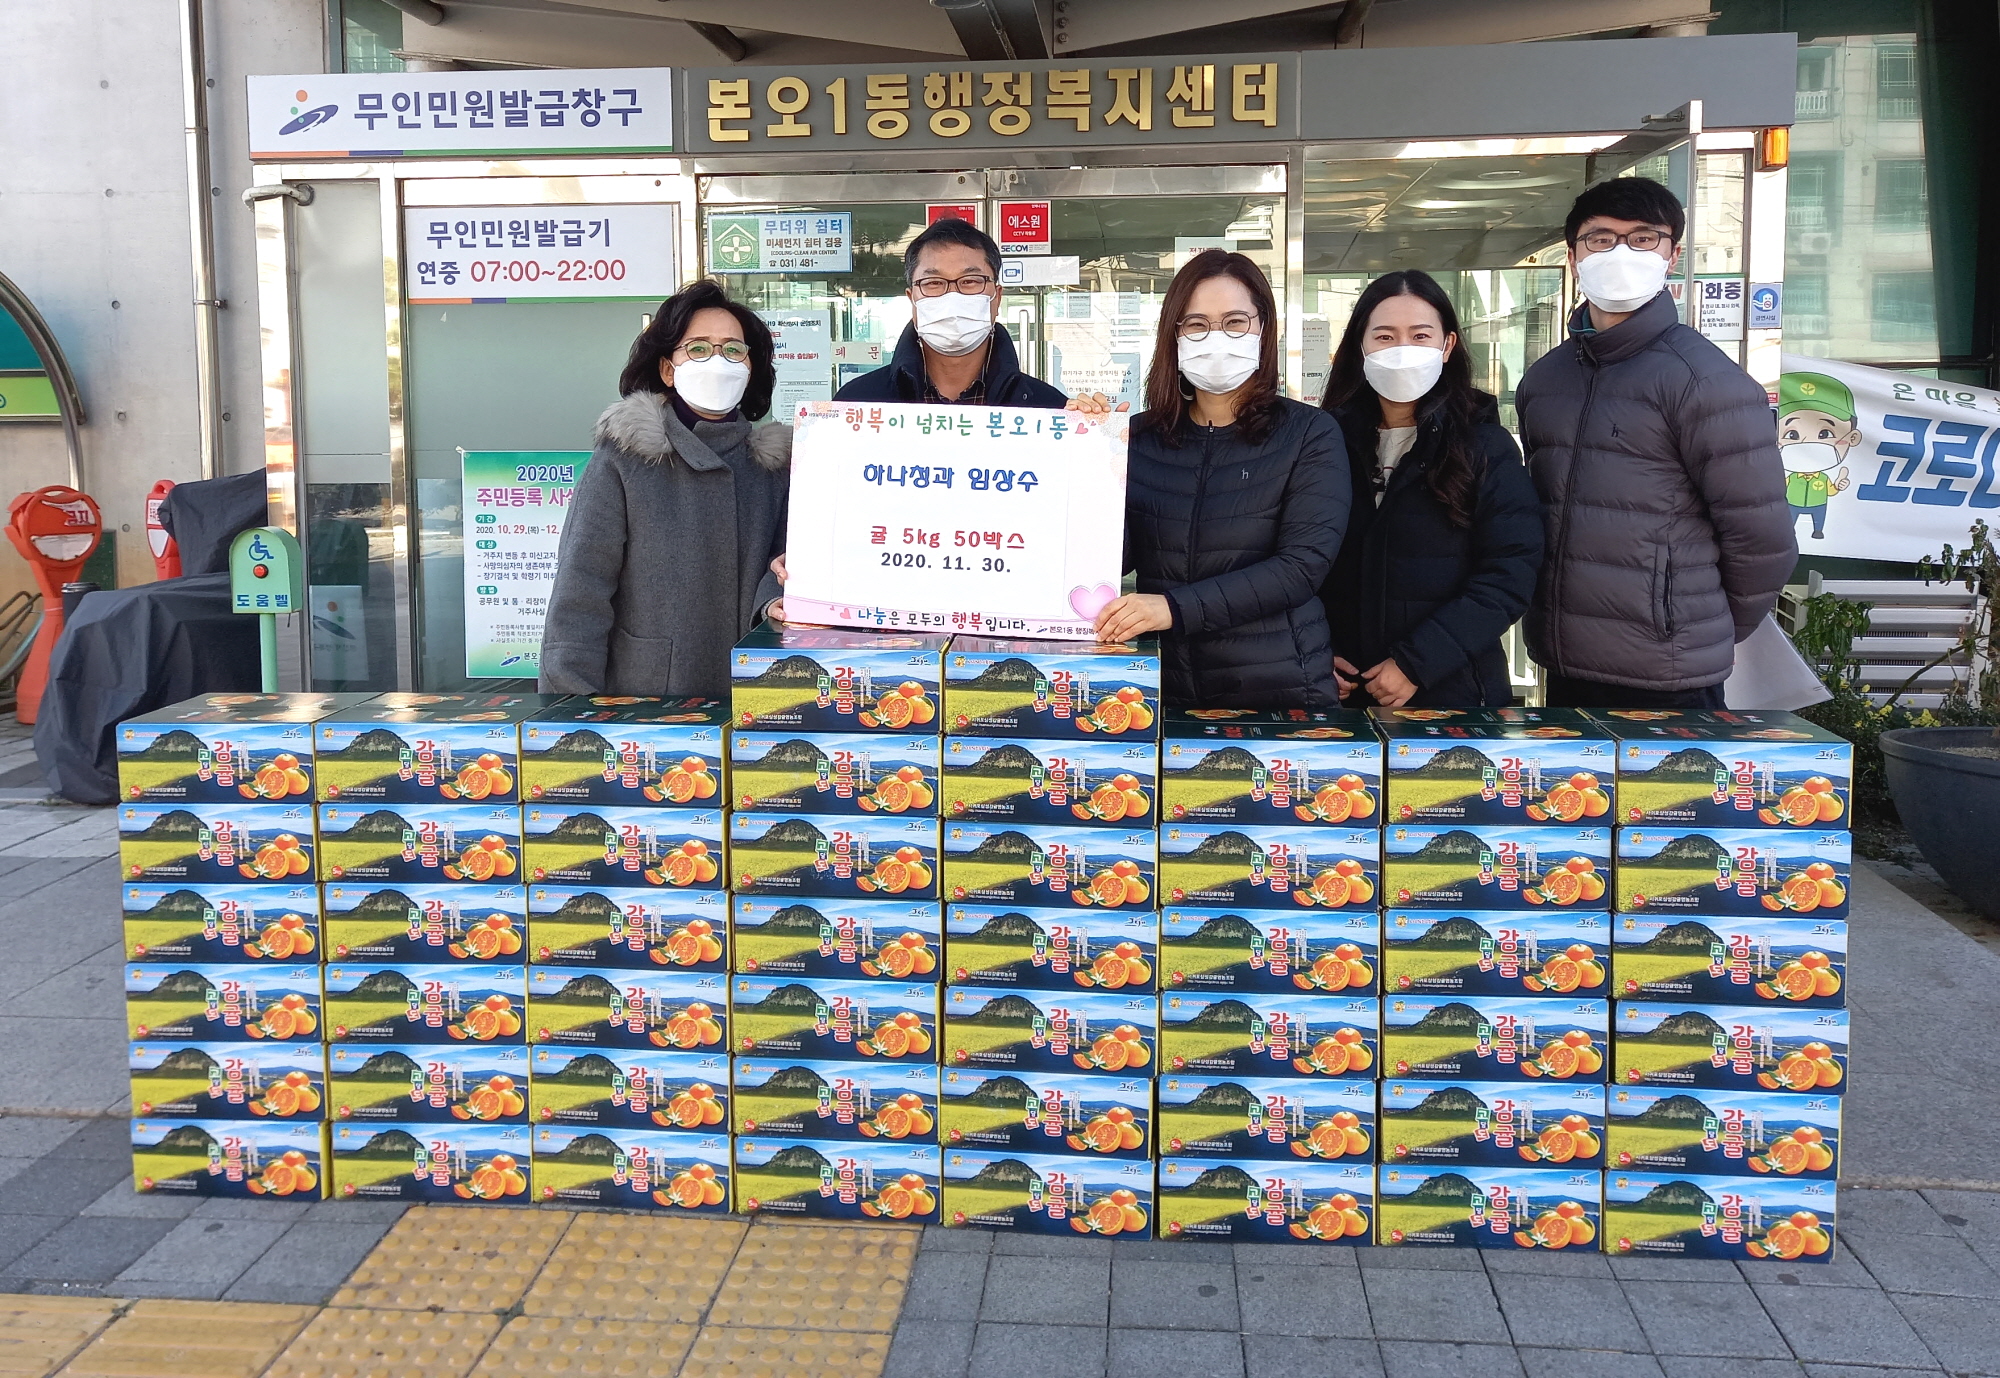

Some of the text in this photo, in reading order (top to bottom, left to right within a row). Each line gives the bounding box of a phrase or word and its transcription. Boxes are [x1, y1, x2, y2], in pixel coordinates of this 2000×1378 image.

[353, 86, 643, 130] 무인민원발급창구
[706, 62, 1278, 142] 본오1동행정복지센터
[426, 217, 611, 250] 무인민원발급기
[764, 219, 843, 234] 무더위 쉼터
[766, 238, 801, 248] 미세먼지
[804, 238, 821, 248] 쉼터
[1008, 215, 1040, 228] 에스원
[416, 258, 626, 286] 연중 07:00~22:00
[780, 258, 818, 268] 031) 481-
[1702, 282, 1741, 300] 화중
[868, 346, 879, 359] 문
[846, 408, 905, 433] 행복이
[916, 412, 973, 436] 넘치는
[516, 464, 574, 483] 2020년
[864, 463, 1039, 493] 하나청과 임상수
[477, 487, 542, 507] 주민등록
[476, 526, 495, 534] 2020.
[498, 524, 511, 534] 10.
[870, 526, 1025, 550] 귤 5kg 50박스
[483, 551, 503, 560] 거주지
[505, 551, 518, 560] 변동
[520, 551, 527, 560] 후
[483, 561, 523, 571] 사망의심자의
[525, 561, 552, 570] 생존여부
[484, 572, 509, 581] 장기결석
[512, 572, 519, 581] 및
[521, 571, 541, 581] 학령기
[881, 551, 1011, 573] 2020. 11. 30.
[237, 594, 289, 608] 도움벨
[479, 597, 499, 606] 공무원
[502, 597, 509, 606] 및
[517, 608, 545, 616] 거주사실
[858, 607, 1030, 633] 나눔은 모두의 행복입니다.
[1050, 626, 1073, 635] 본오1동
[834, 666, 856, 714] 감귤
[1051, 670, 1072, 718] 감귤
[214, 741, 234, 785] 감귤
[415, 740, 436, 785] 감귤
[620, 741, 641, 787] 감귤
[833, 750, 854, 798] 감귤
[1047, 756, 1069, 805] 감귤
[1269, 758, 1291, 807] 감귤
[1500, 756, 1523, 807] 감귤
[1733, 759, 1756, 811] 감귤
[215, 821, 235, 865] 감귤
[419, 821, 440, 867] 감귤
[621, 825, 642, 870] 감귤
[832, 830, 854, 878] 감귤
[1047, 843, 1069, 892] 감귤
[1268, 843, 1290, 892] 감귤
[1497, 841, 1519, 891] 감귤
[1736, 845, 1759, 897] 감귤
[219, 900, 240, 945] 감귤
[424, 900, 445, 945] 감귤
[626, 904, 647, 949] 감귤
[837, 916, 858, 962] 감귤
[1050, 925, 1072, 972] 감귤
[1268, 926, 1290, 976] 감귤
[1498, 928, 1520, 978] 감귤
[1729, 933, 1753, 985] 감귤
[222, 981, 242, 1025] 감귤
[423, 981, 444, 1026] 감귤
[626, 987, 647, 1032] 감귤
[832, 996, 853, 1041] 감귤
[1049, 1007, 1070, 1054] 감귤
[1268, 1011, 1290, 1060] 감귤
[1495, 1014, 1517, 1064] 감귤
[1732, 1023, 1755, 1075] 감귤
[224, 1058, 245, 1103] 감귤
[427, 1062, 448, 1107] 감귤
[628, 1066, 649, 1111] 감귤
[834, 1078, 855, 1123] 감귤
[1043, 1089, 1064, 1135] 감귤
[1265, 1094, 1287, 1143] 감귤
[1493, 1098, 1515, 1148] 감귤
[1722, 1107, 1745, 1158] 감귤
[223, 1136, 244, 1181] 감귤
[430, 1140, 451, 1185] 감귤
[630, 1146, 651, 1191] 감귤
[837, 1157, 858, 1203] 감귤
[1047, 1172, 1068, 1218] 감귤
[1264, 1177, 1286, 1226] 감귤
[1489, 1184, 1511, 1234] 감귤
[1720, 1193, 1742, 1243] 감귤
